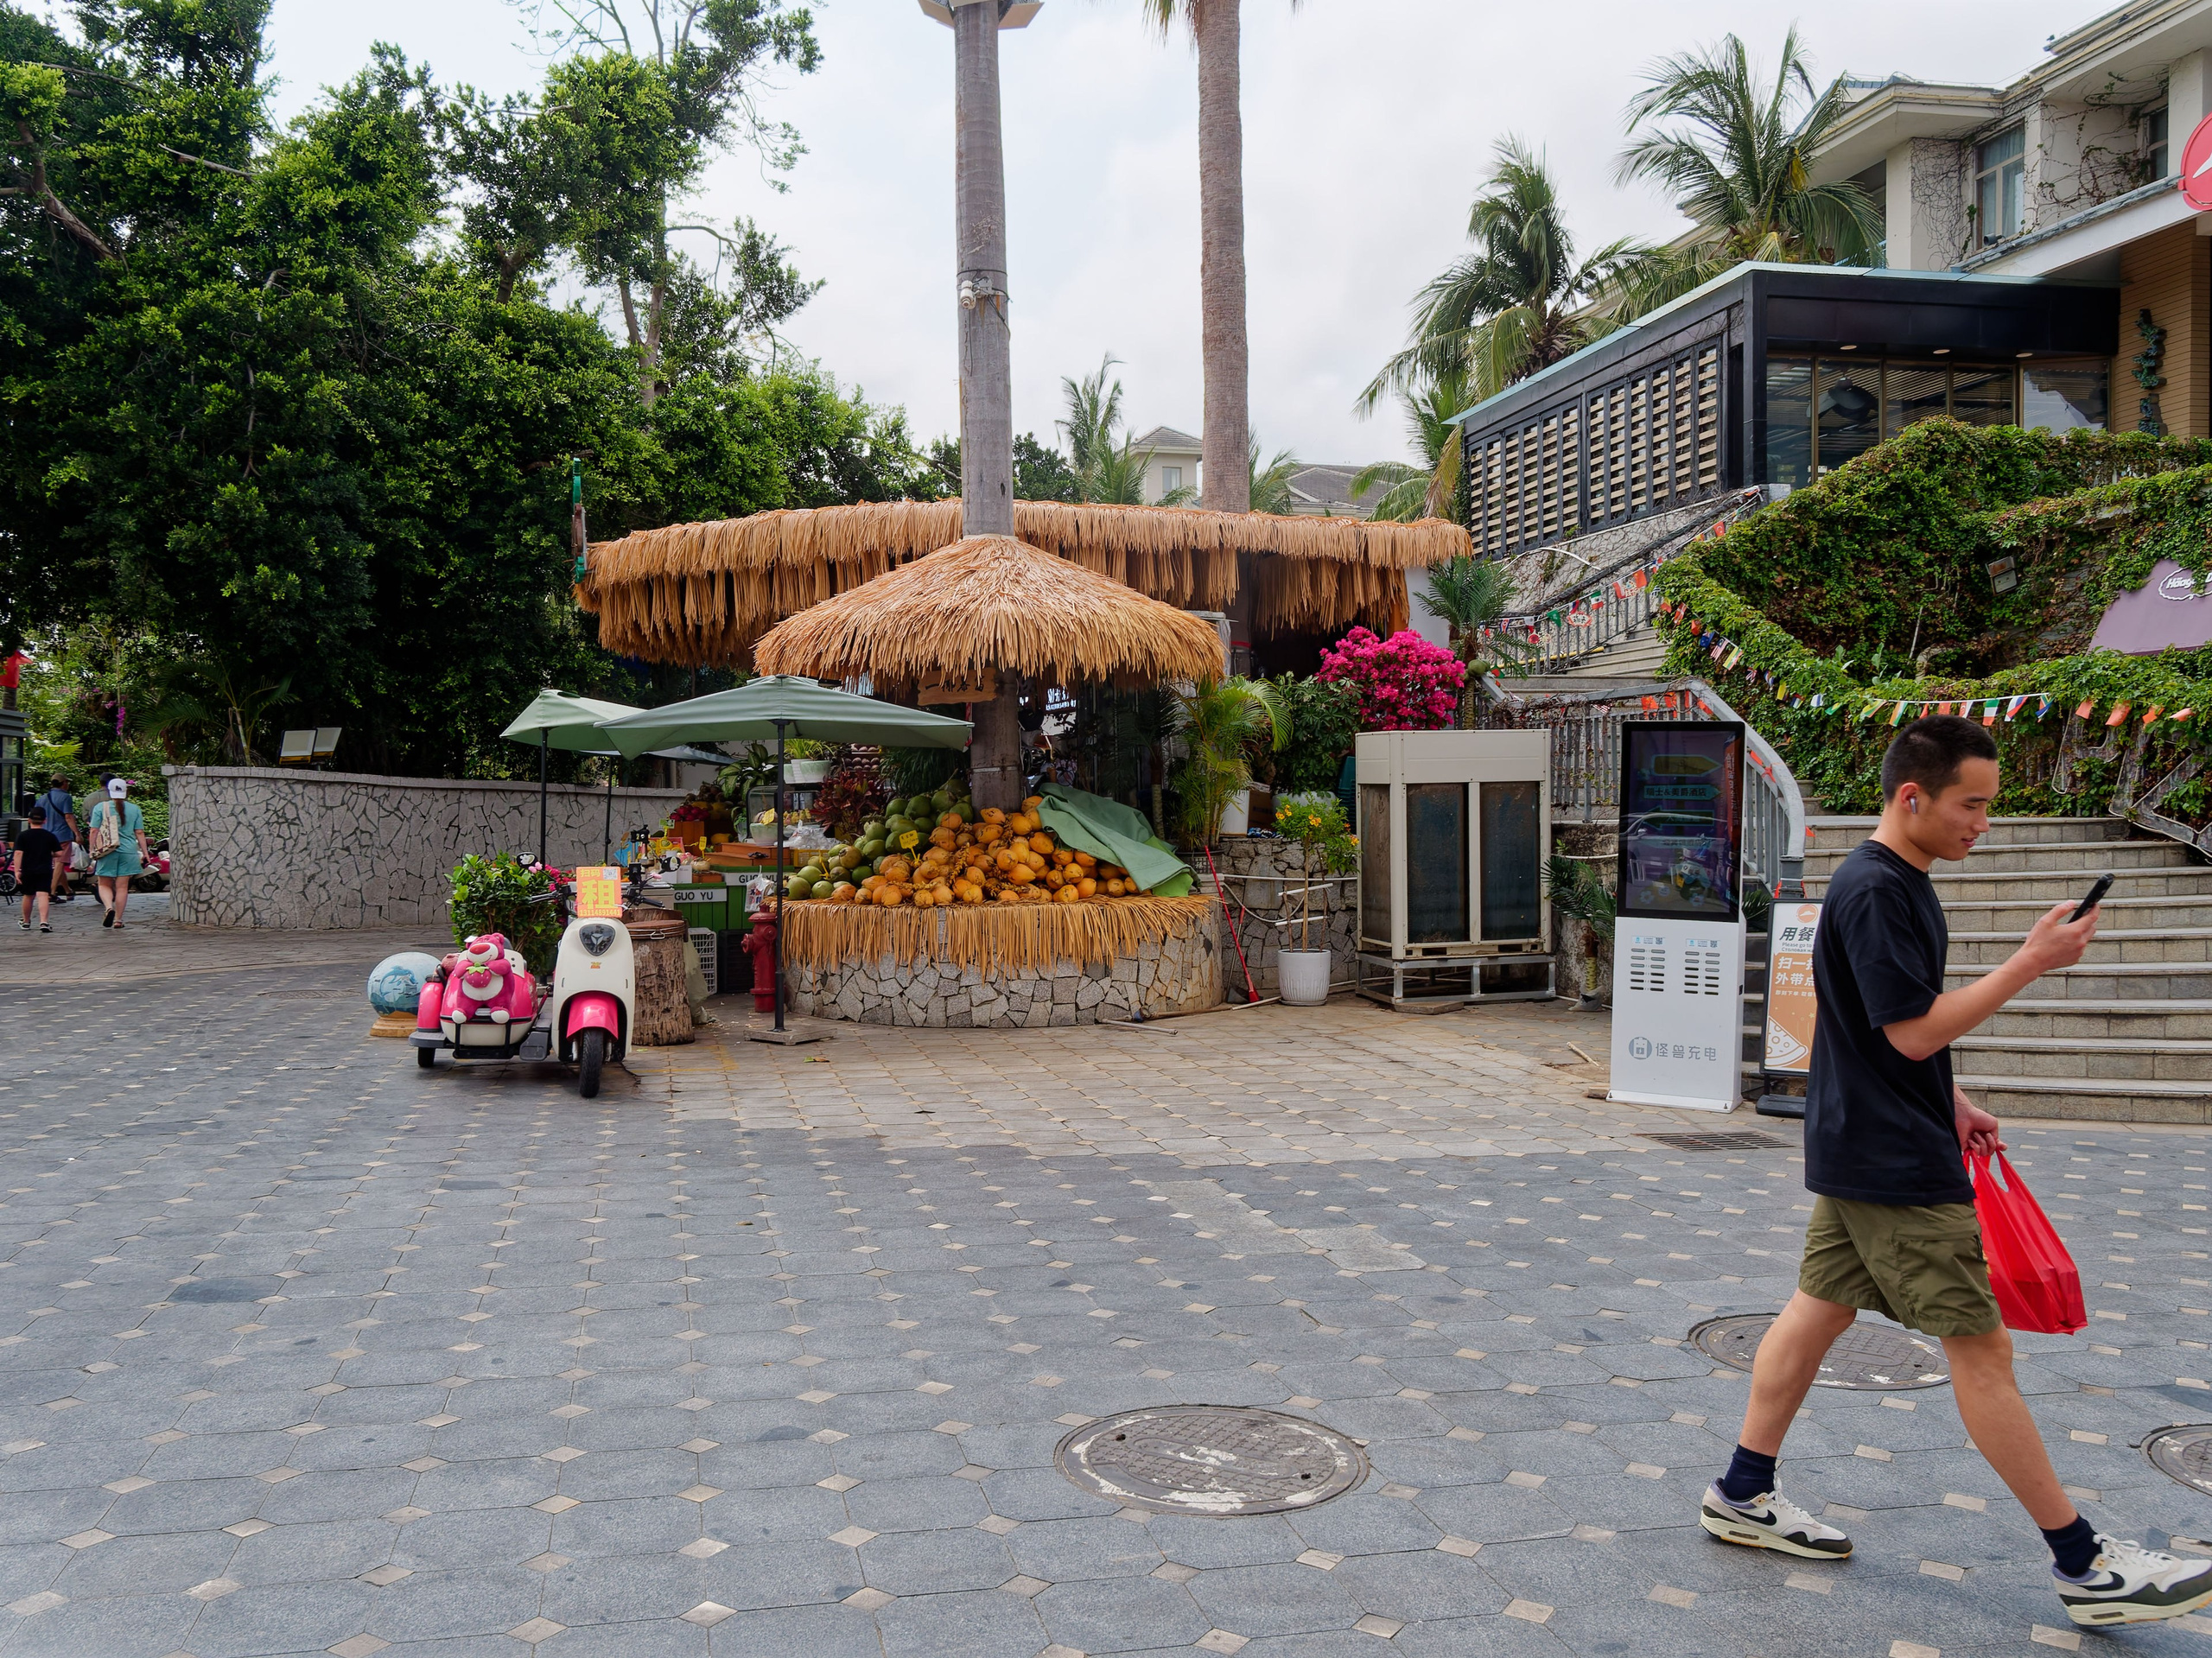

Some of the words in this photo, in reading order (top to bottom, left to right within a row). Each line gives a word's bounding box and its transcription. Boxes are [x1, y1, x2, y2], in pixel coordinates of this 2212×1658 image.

[580, 868, 601, 877] 扫码
[582, 879, 619, 910] 租
[674, 892, 695, 900] GUO
[701, 891, 713, 900] YU
[1656, 1043, 1716, 1061] 怪兽充电
